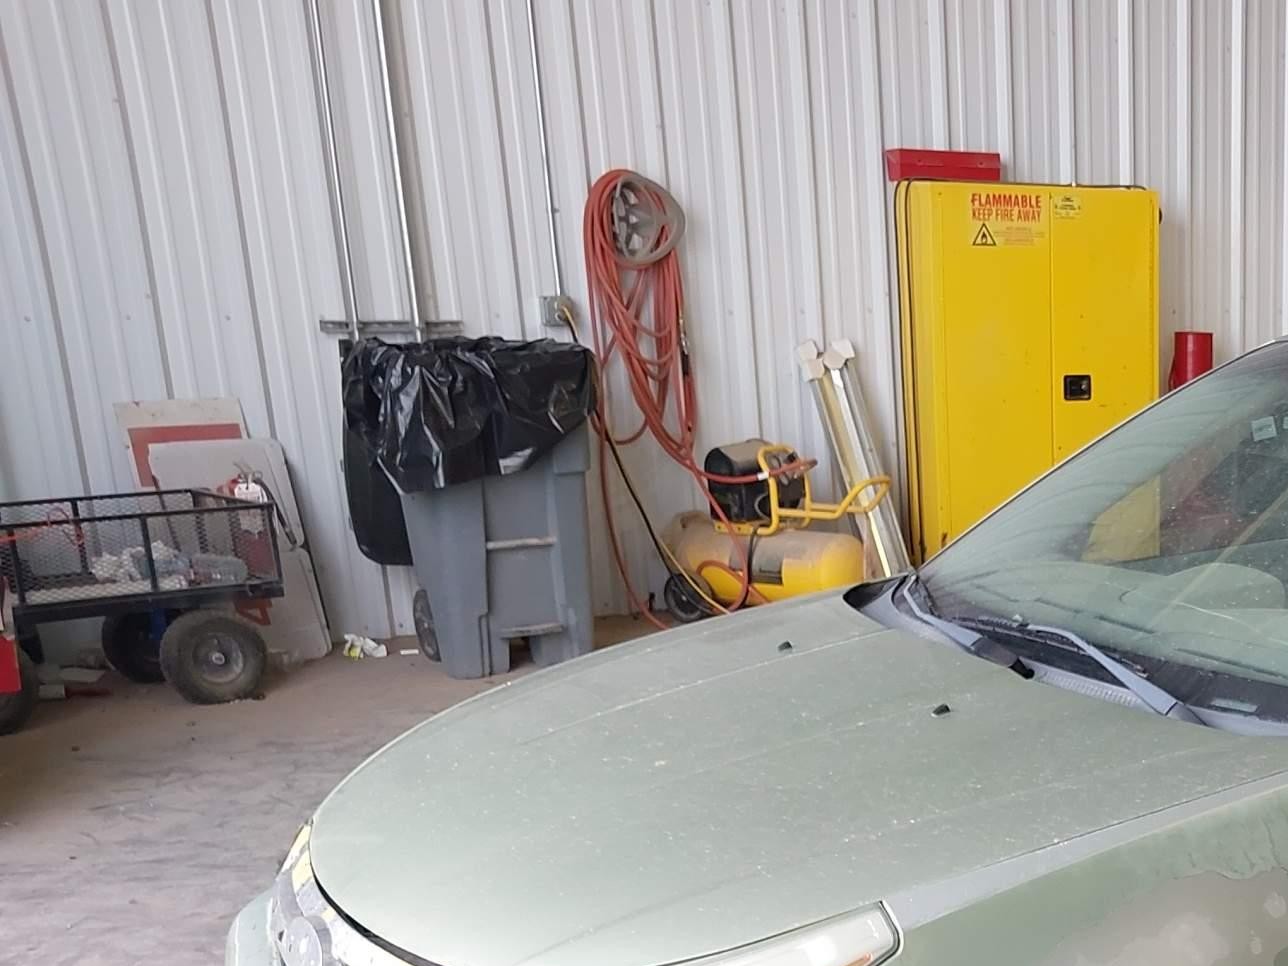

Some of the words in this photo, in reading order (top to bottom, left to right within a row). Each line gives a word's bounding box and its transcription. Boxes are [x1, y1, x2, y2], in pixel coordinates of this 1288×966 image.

[971, 193, 1042, 209] FLAMMABLE
[972, 207, 994, 221] KEEP
[995, 208, 1015, 222] FIRE
[1016, 208, 1042, 223] AWAY
